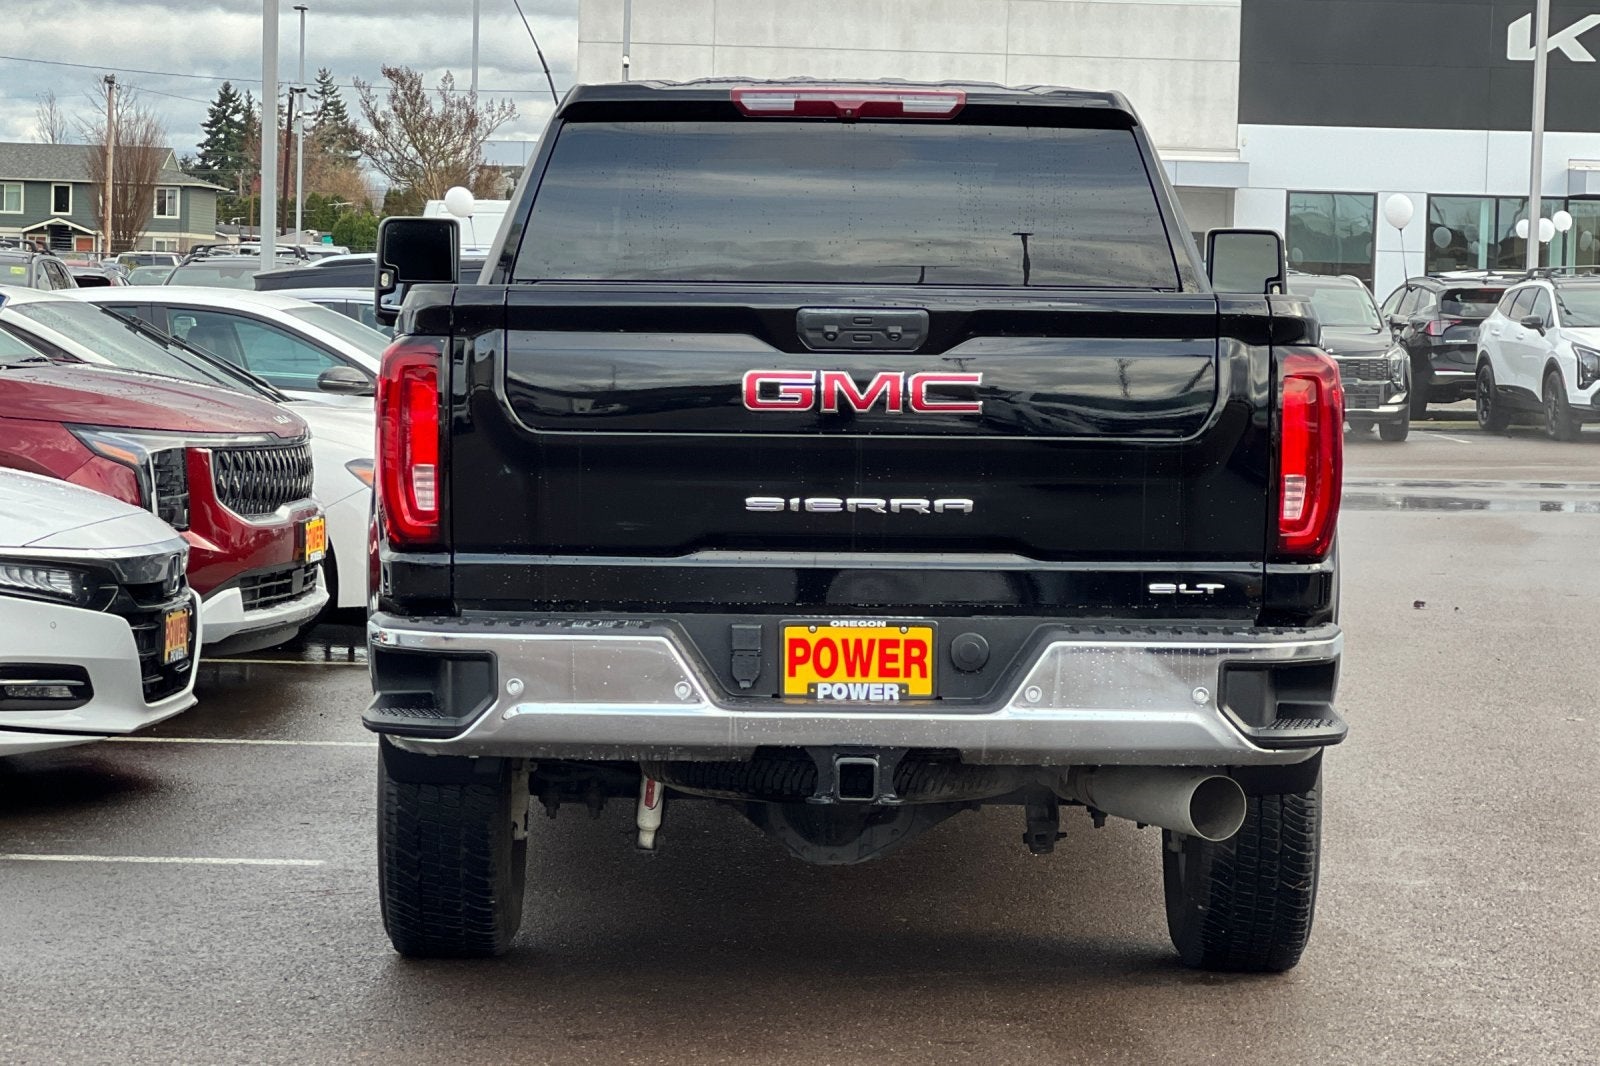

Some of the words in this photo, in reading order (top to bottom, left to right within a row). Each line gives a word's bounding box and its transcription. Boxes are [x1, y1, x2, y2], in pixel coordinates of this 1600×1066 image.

[742, 370, 983, 414] GMC
[745, 496, 974, 514] SIERRA
[1149, 583, 1226, 595] SLT
[830, 620, 887, 628] OREGON
[788, 637, 928, 679] POWER
[817, 684, 899, 700] POWER
